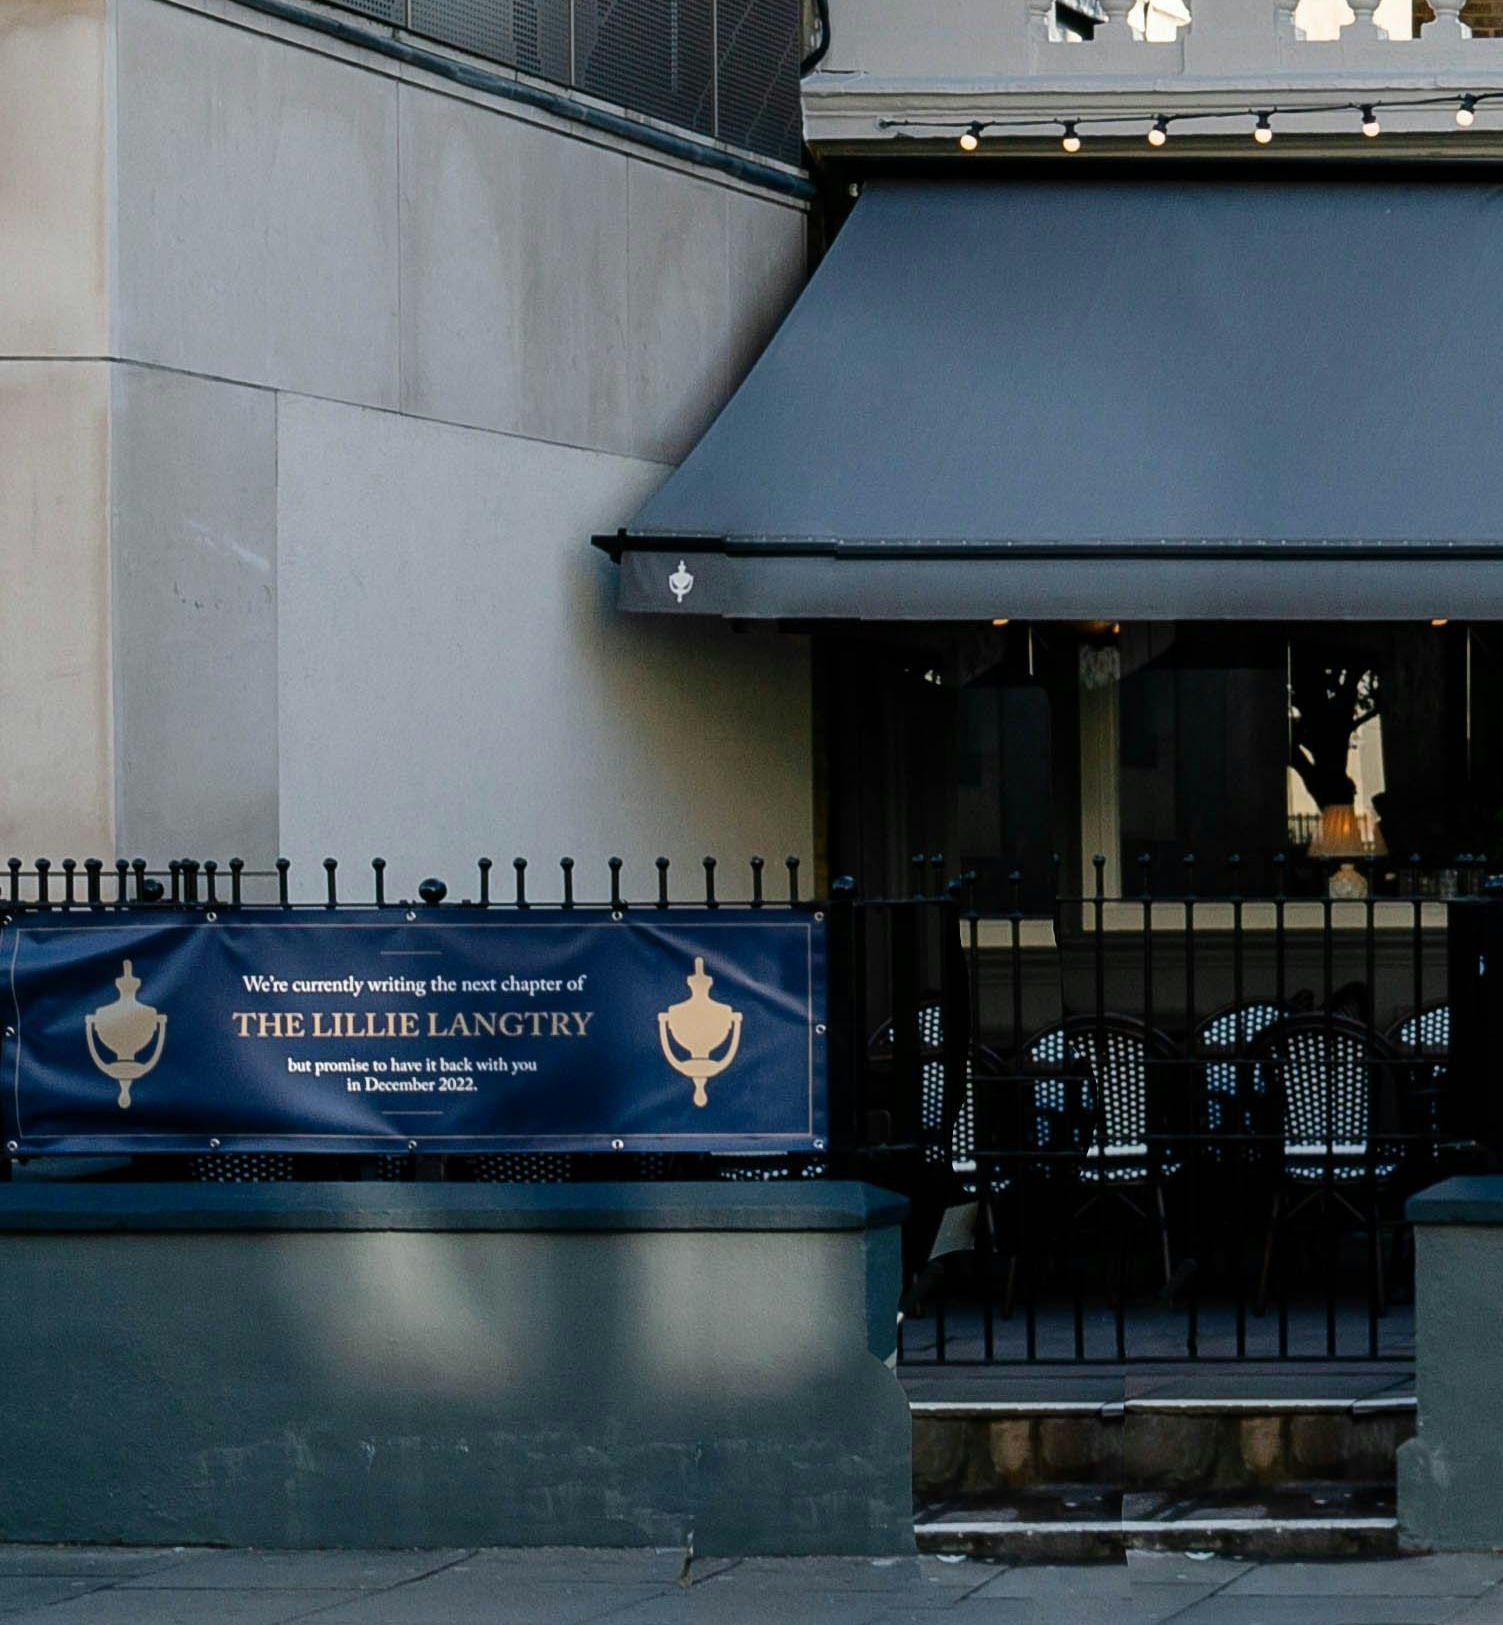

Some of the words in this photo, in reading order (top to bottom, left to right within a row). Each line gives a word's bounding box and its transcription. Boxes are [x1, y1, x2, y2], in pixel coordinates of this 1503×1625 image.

[242, 974, 289, 993] We're
[291, 974, 365, 998] currently
[366, 975, 427, 998] writing
[430, 974, 457, 993] the
[461, 978, 497, 992] next
[500, 974, 563, 997] chapter
[566, 974, 588, 992] of
[231, 1011, 306, 1038] THE
[311, 1012, 420, 1038] LILLIE
[427, 1011, 593, 1037] LANGTRY
[287, 1057, 312, 1073] but
[314, 1057, 370, 1077] promise
[372, 1060, 388, 1073] to
[390, 1056, 423, 1073] have
[425, 1057, 437, 1073] it
[439, 1056, 474, 1073] back
[475, 1056, 509, 1072] with
[511, 1061, 538, 1076] you
[346, 1077, 362, 1092] in
[364, 1076, 436, 1092] December
[437, 1076, 478, 1092] 2022.
